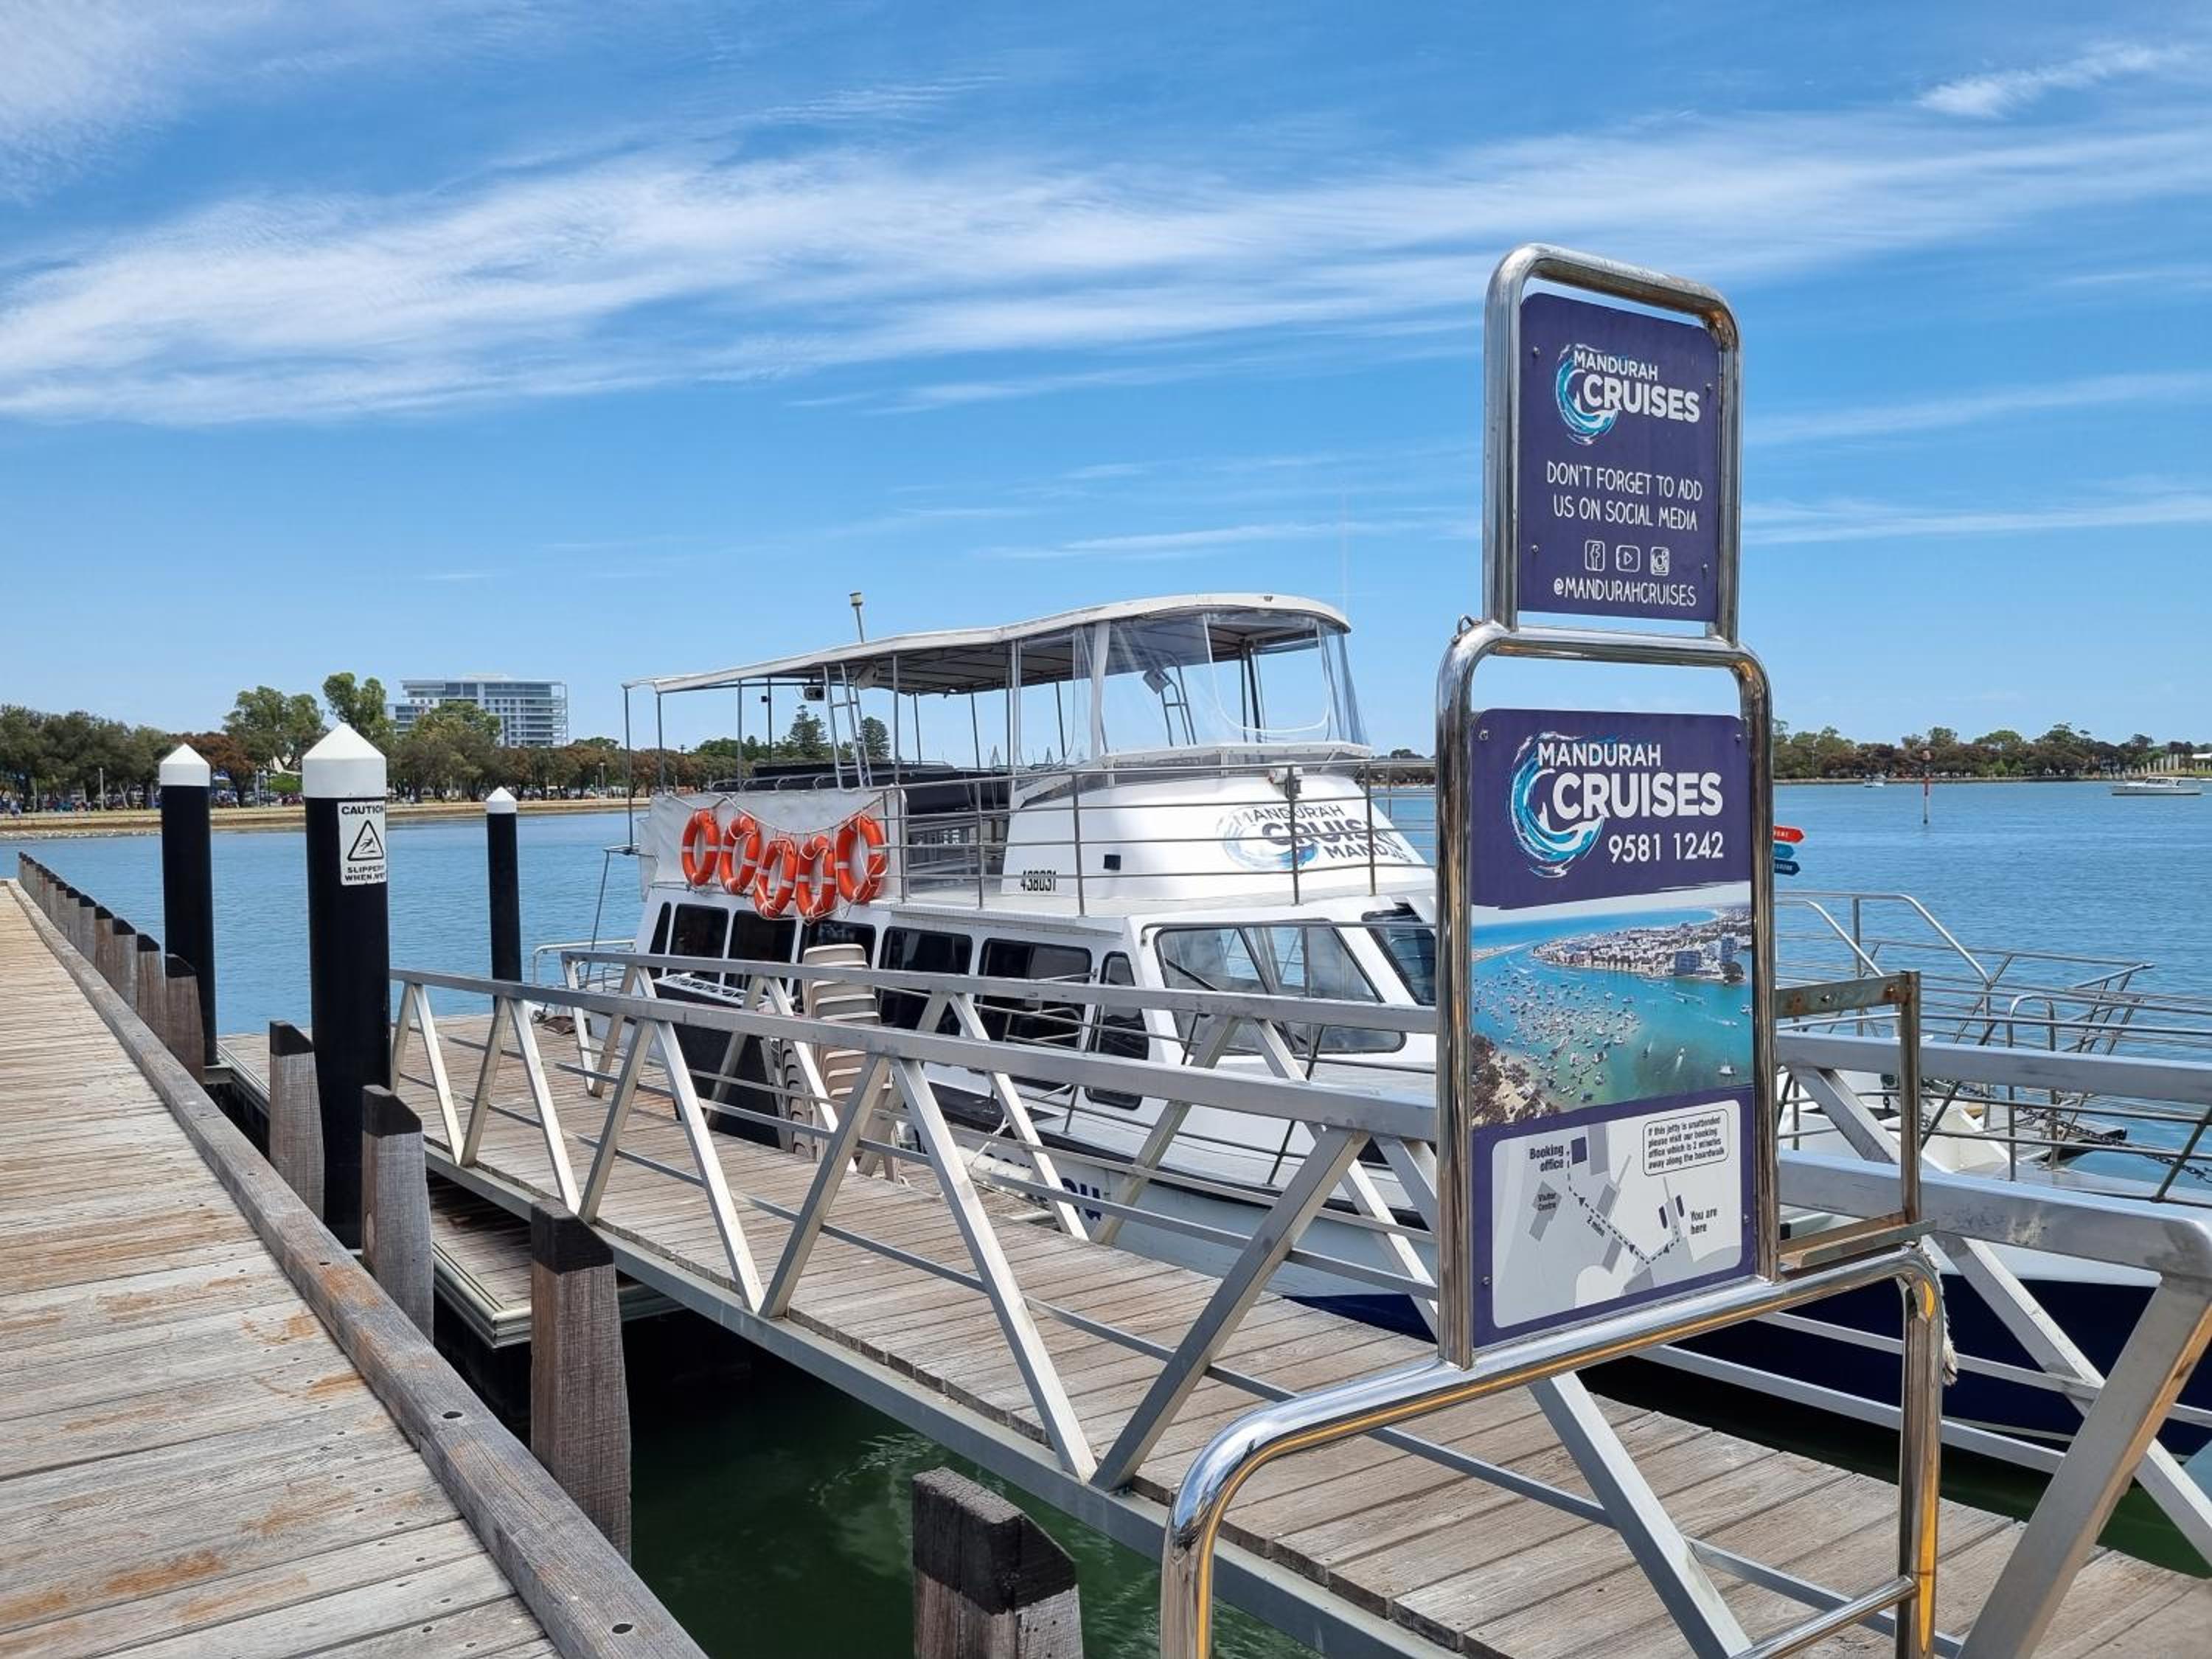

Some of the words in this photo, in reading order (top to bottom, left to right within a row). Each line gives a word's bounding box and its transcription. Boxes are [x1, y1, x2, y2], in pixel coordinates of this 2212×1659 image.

[1573, 350, 1658, 381] MANDURAH
[1583, 374, 1700, 423] CRUISES
[1547, 460, 1592, 488] DON'T
[1596, 467, 1652, 495] FORGET
[1655, 475, 1674, 498] TO
[1677, 479, 1703, 501] ADD
[1554, 493, 1574, 518] US
[1579, 497, 1601, 521] ON
[1605, 500, 1653, 526] SOCIAL
[1658, 507, 1697, 531] MEDIA
[1554, 577, 1696, 606] @MANDURAHCRUISES
[1537, 742, 1661, 766] MANDURAH
[1552, 772, 1723, 819] CRUISES
[1608, 833, 1661, 863] 9581
[1673, 831, 1723, 860] 1242
[1529, 1144, 1564, 1160] Booking
[1649, 1138, 1668, 1149] please
[1540, 1158, 1564, 1172] office
[1690, 1210, 1703, 1222] You
[1705, 1208, 1717, 1219] are
[1690, 1223, 1707, 1235] here
